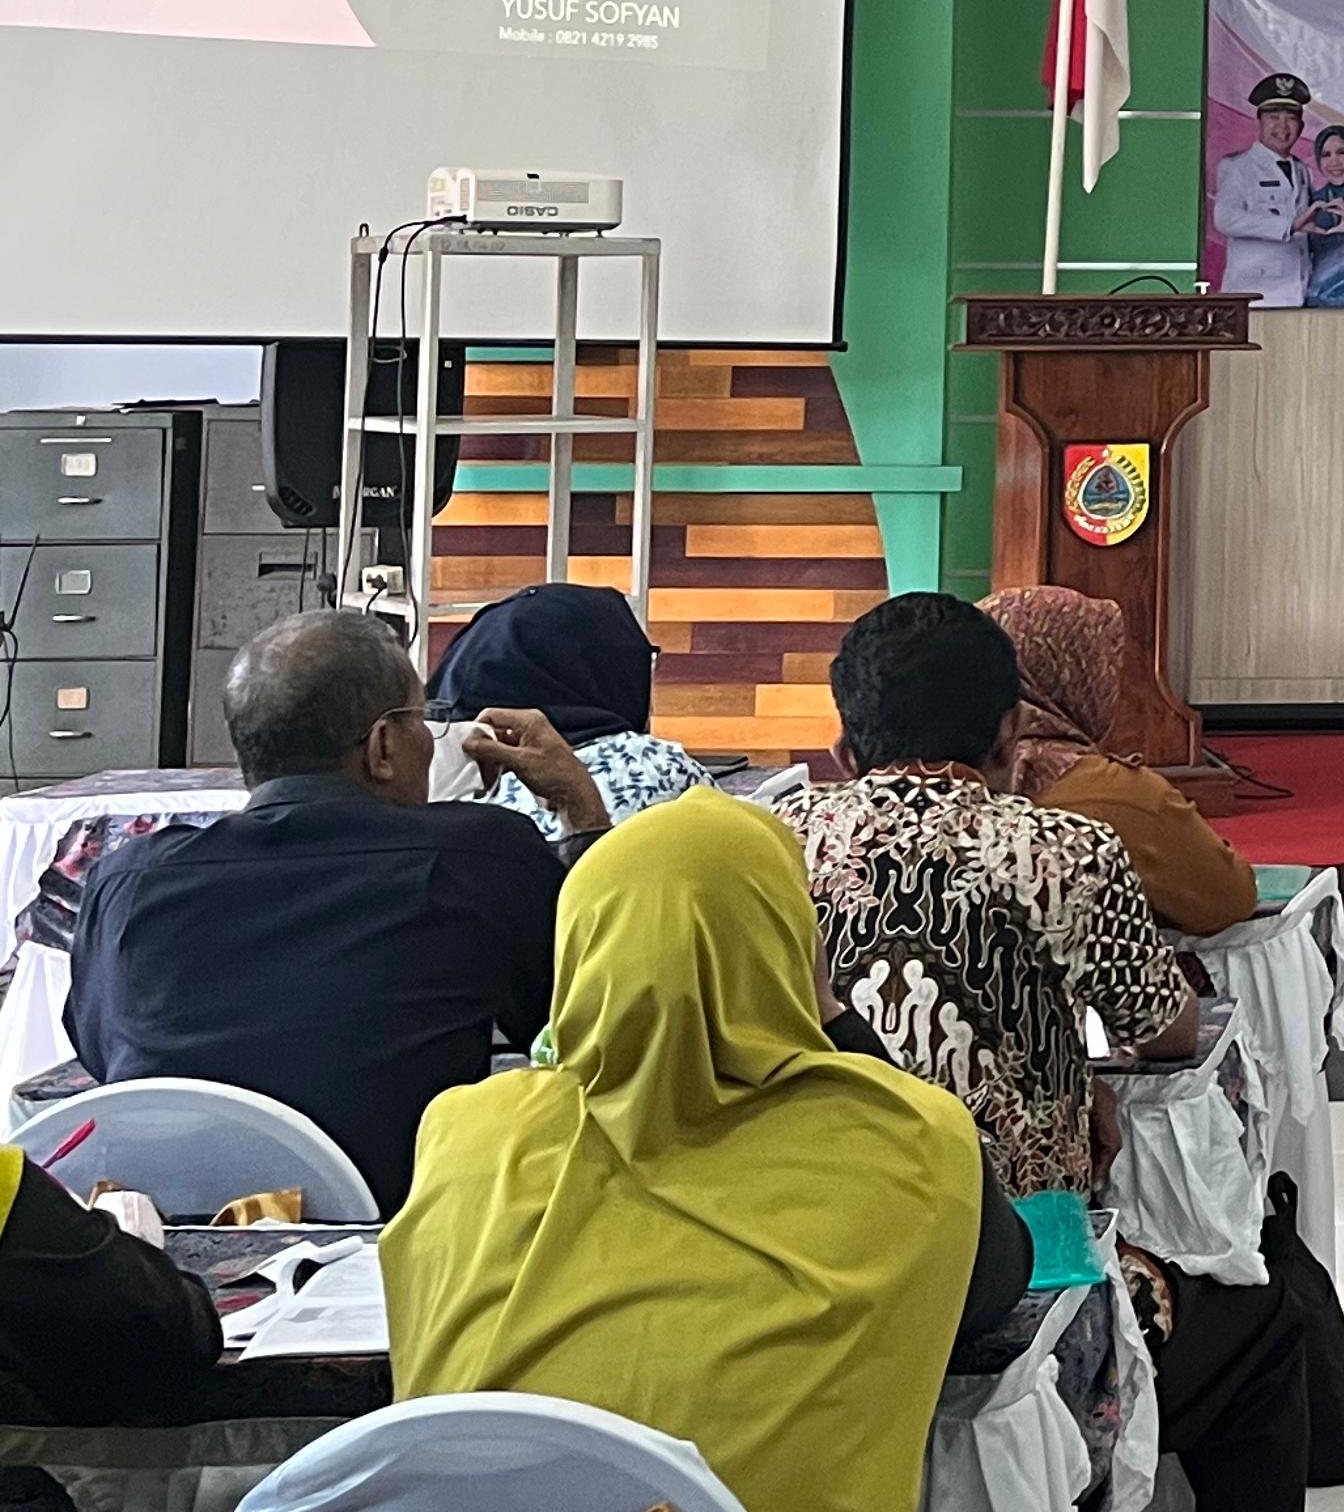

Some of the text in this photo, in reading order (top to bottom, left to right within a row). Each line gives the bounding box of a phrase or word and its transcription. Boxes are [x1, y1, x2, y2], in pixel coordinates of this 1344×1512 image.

[585, 0, 680, 29] SOFYAN
[499, 26, 545, 43] Mobile
[555, 29, 587, 45] 0821
[591, 32, 625, 47] 4219
[506, 205, 559, 217] CASIO
